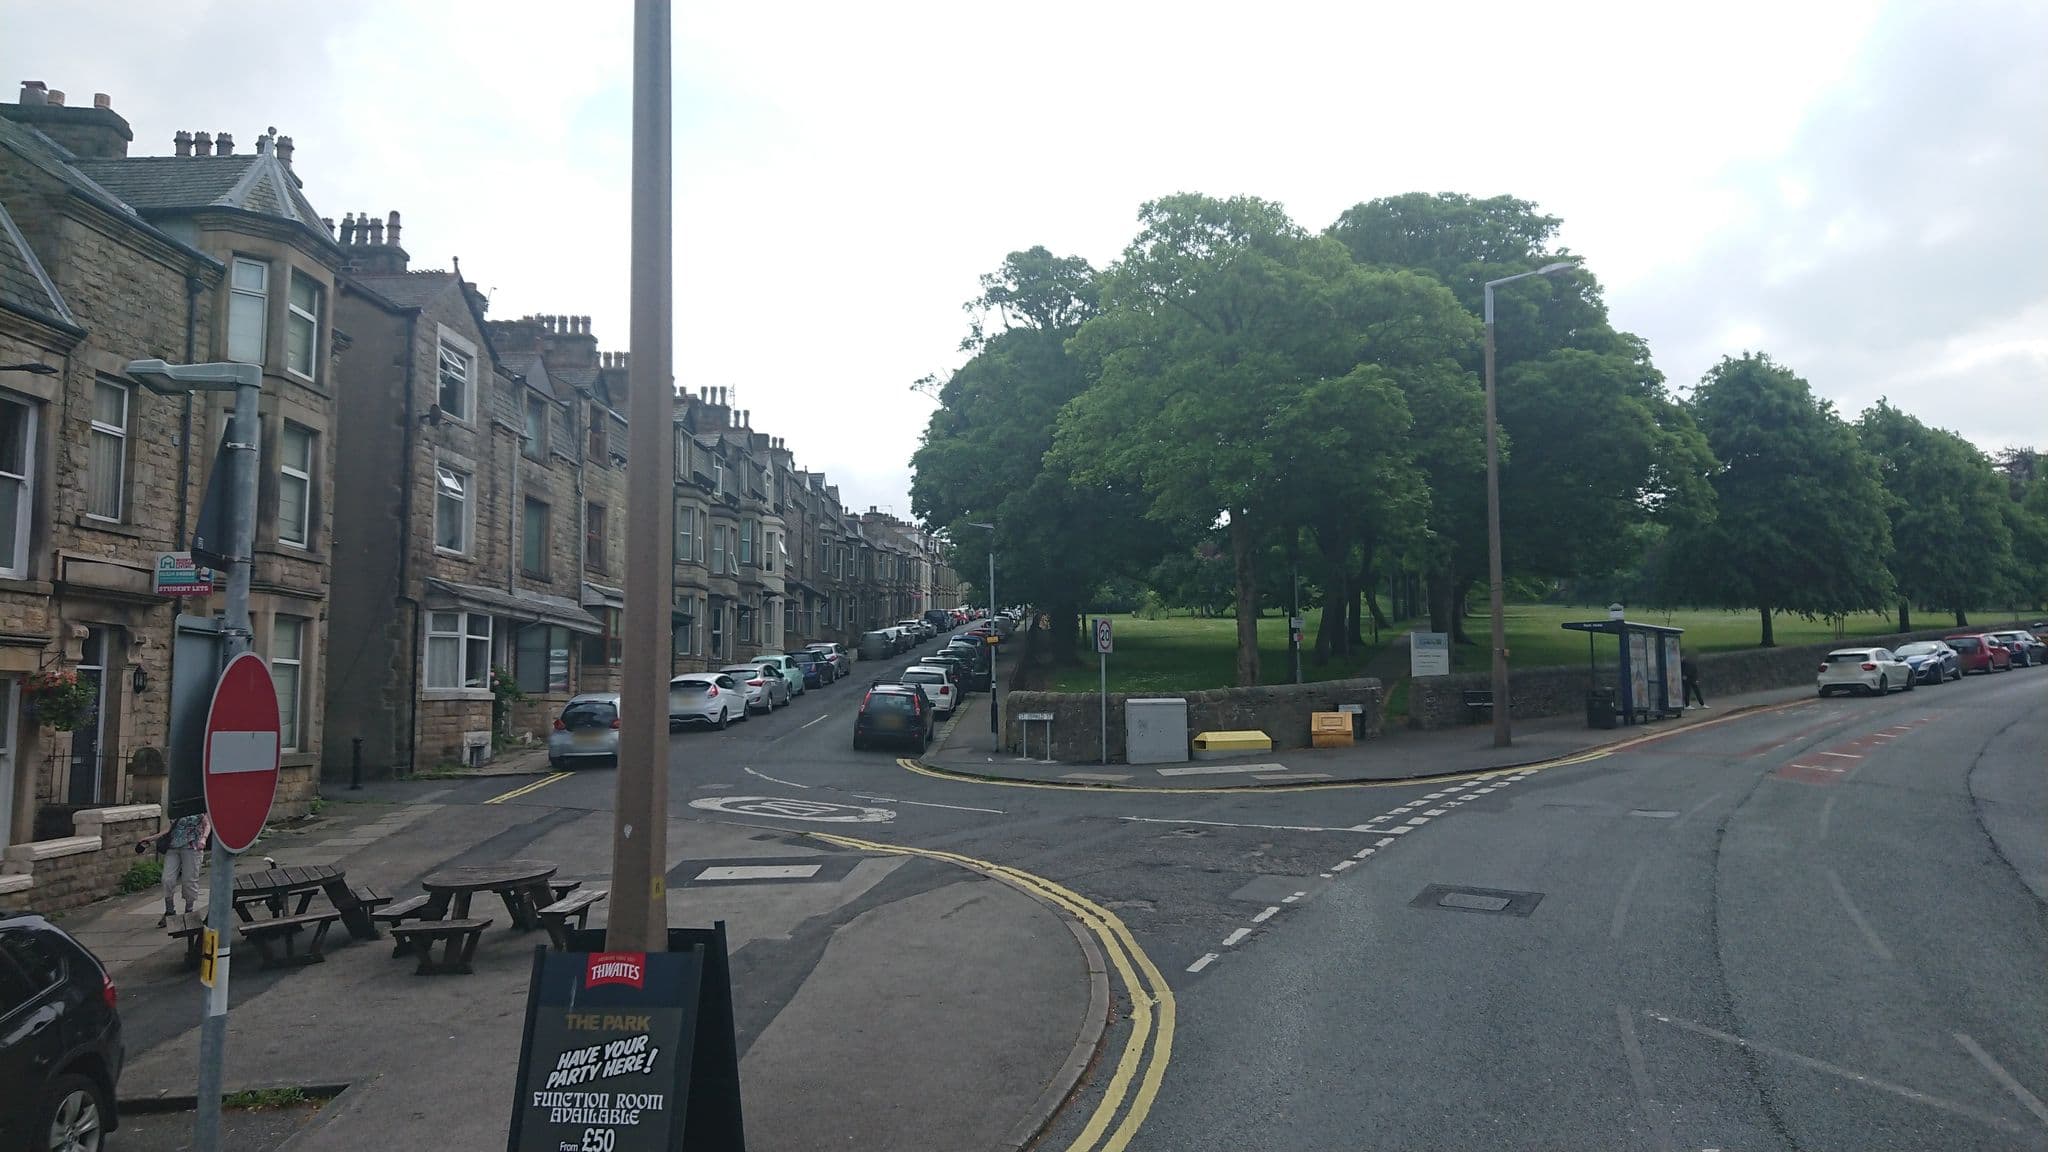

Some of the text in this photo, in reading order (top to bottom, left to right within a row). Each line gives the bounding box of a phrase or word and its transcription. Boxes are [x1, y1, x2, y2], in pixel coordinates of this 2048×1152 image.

[1101, 629, 1110, 641] 20
[737, 801, 839, 816] 20
[591, 962, 640, 980] THWAITES
[567, 1015, 651, 1031] THE PARK
[556, 1034, 648, 1070] HAVE YOUR
[545, 1047, 658, 1089] PARTY HERE!
[532, 1092, 664, 1110] FUNCTION ROOM
[549, 1107, 641, 1125] AVAILABLE
[559, 1127, 616, 1152] From £50
